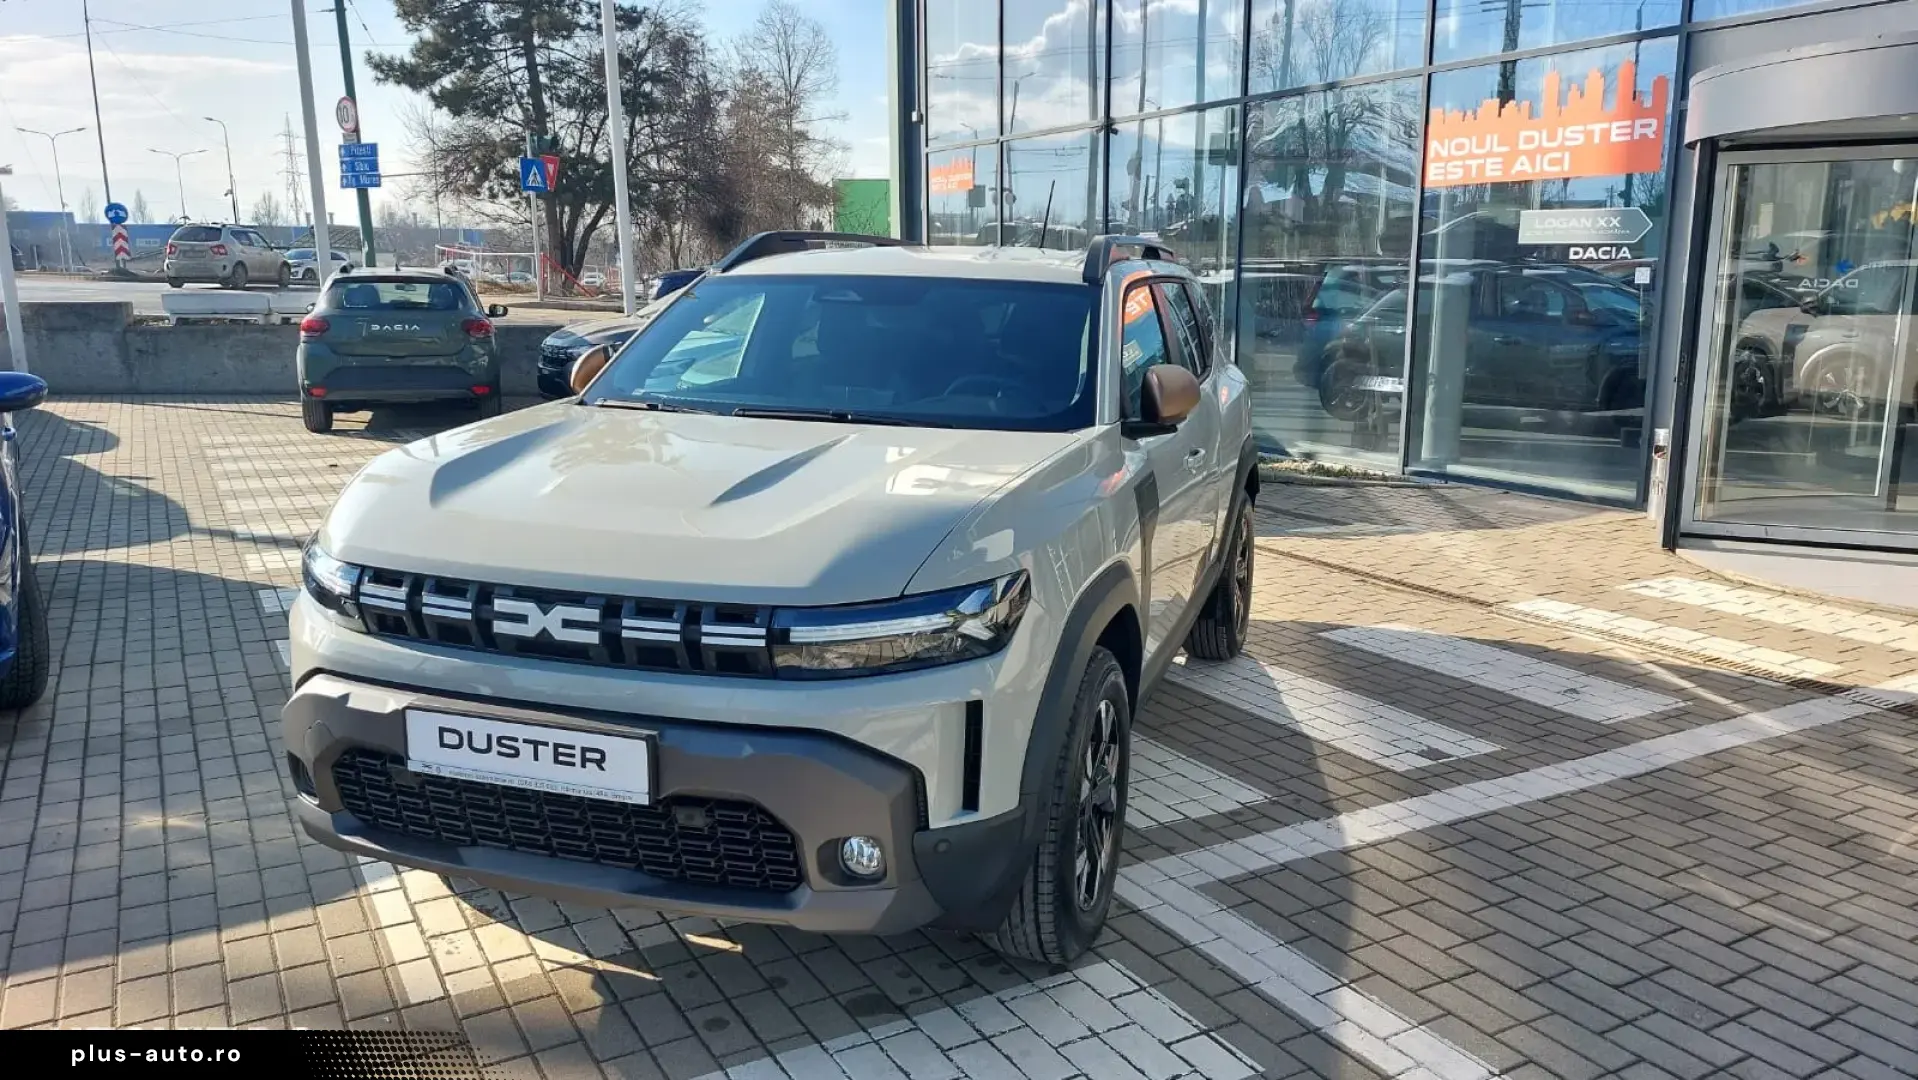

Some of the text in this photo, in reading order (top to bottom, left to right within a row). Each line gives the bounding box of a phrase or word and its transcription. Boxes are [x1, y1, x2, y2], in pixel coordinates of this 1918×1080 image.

[1430, 118, 1658, 159] NOUL DUSTER
[1428, 151, 1571, 181] ESTE AICI
[1535, 216, 1622, 229] LOGAN XX
[1568, 246, 1632, 259] DACIA
[438, 725, 607, 772] DUSTER
